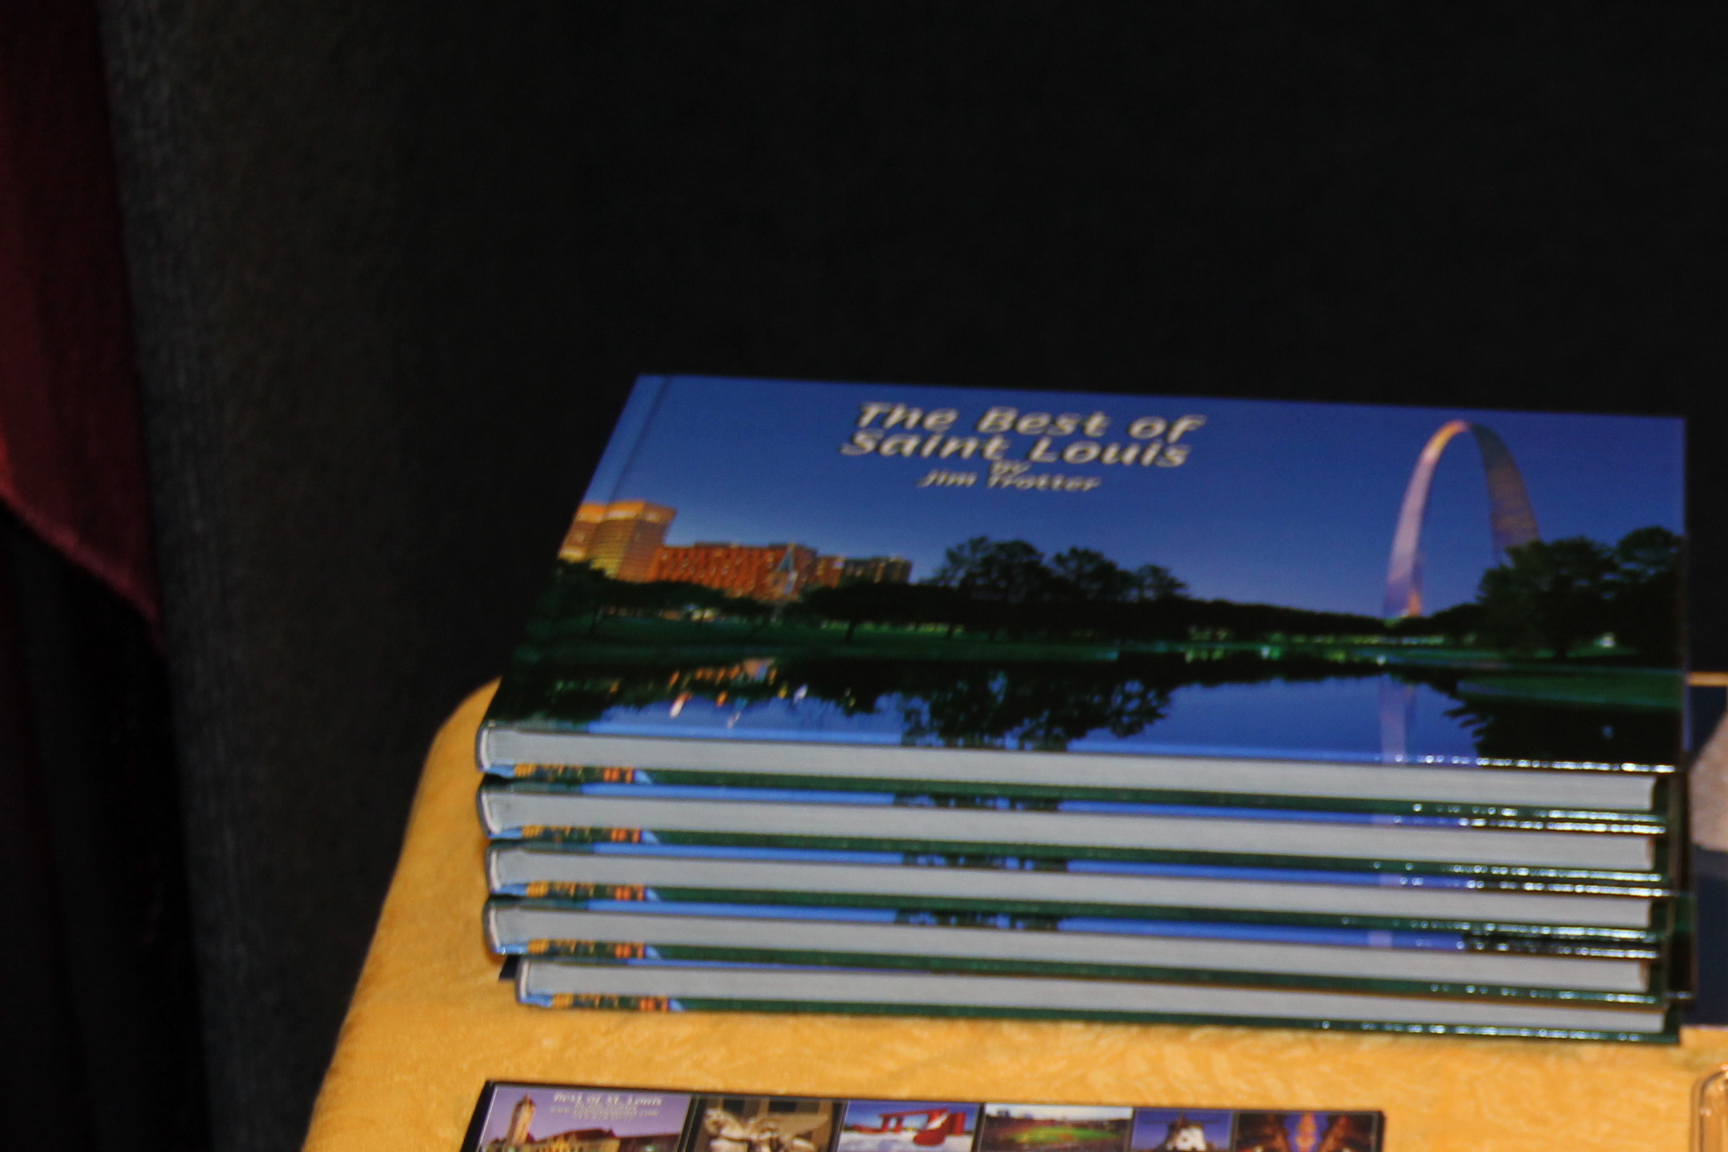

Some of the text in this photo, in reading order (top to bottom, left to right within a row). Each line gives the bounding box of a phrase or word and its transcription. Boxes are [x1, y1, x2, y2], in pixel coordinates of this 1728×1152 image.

[858, 402, 1206, 443] The Best of
[839, 428, 1191, 467] Saint Louis
[916, 470, 1101, 491] Jim Trotter
